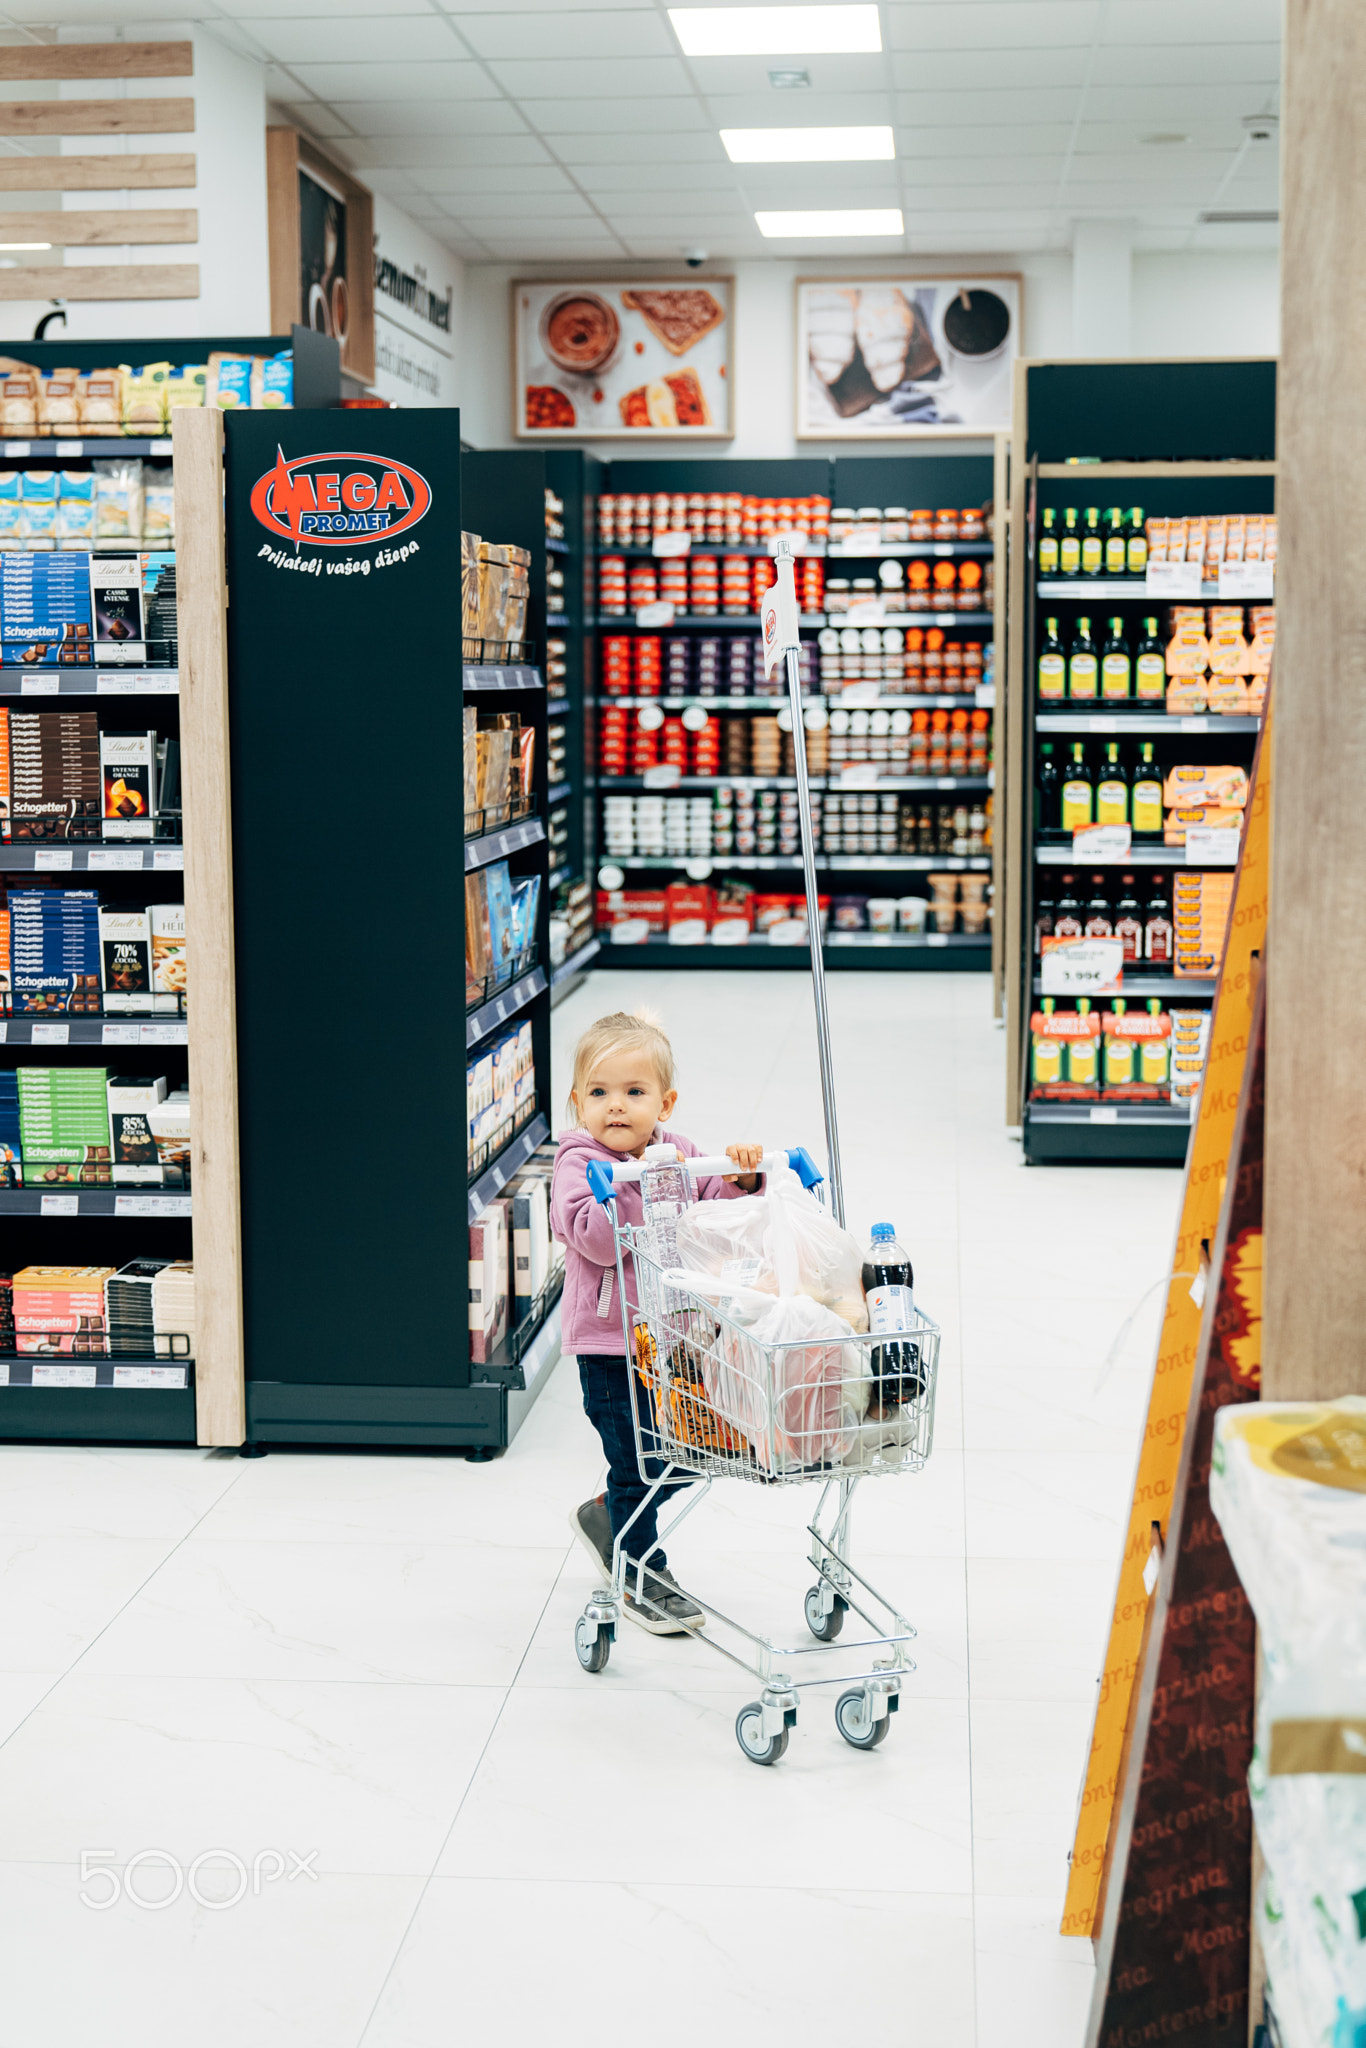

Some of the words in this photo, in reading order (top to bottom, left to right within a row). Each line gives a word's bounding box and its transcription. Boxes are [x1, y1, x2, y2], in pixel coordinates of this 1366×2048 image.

[269, 471, 412, 514] MEGA
[302, 513, 391, 532] PROMET
[257, 543, 322, 576] Prijatelj
[326, 557, 371, 576] vašeg
[375, 540, 420, 568] džepa
[97, 563, 126, 575] Lindt
[4, 626, 59, 638] Schogetten
[107, 742, 137, 751] Lindt
[13, 802, 68, 815] Schogetten
[105, 917, 135, 928] Lindt
[113, 944, 138, 958] 70%
[14, 976, 69, 988] Schogetten
[122, 1116, 146, 1130] 85%
[26, 1146, 79, 1158] Schogetten
[18, 1316, 72, 1329] Schogetten
